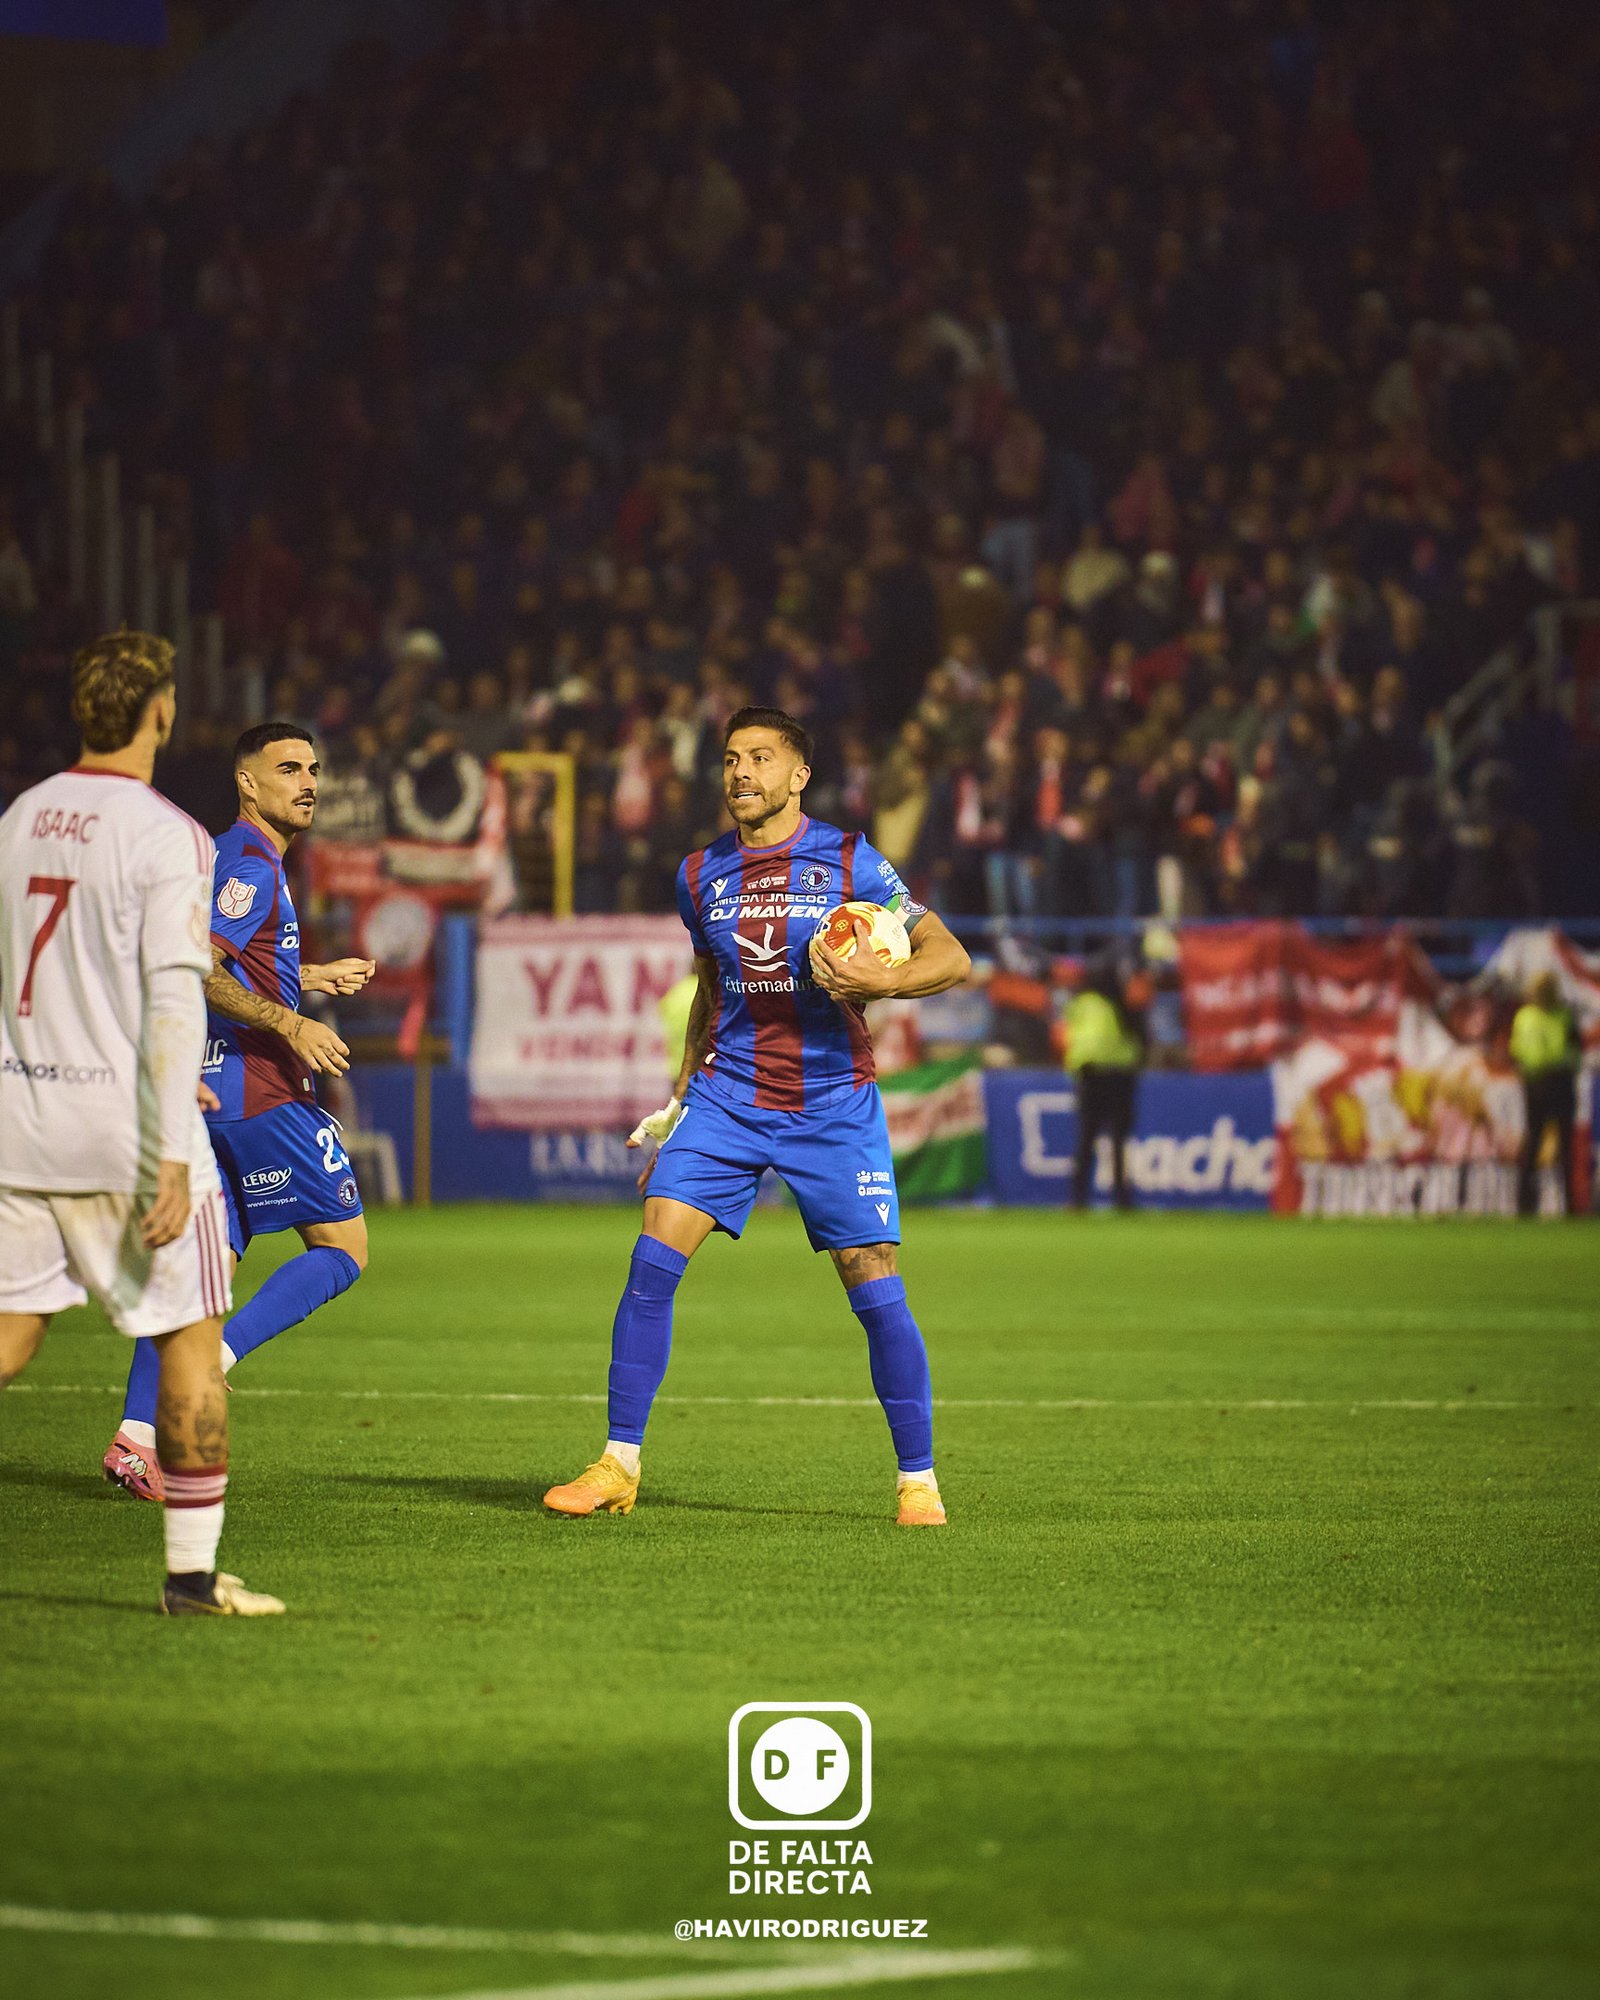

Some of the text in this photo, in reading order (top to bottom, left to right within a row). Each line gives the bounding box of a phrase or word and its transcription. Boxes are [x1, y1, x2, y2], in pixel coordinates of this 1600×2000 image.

[31, 808, 100, 844] ISAAC
[764, 893, 828, 904] JAECOO
[710, 905, 825, 920] OJ MAVEN
[18, 876, 77, 1016] 7
[726, 976, 817, 994] Extremadur
